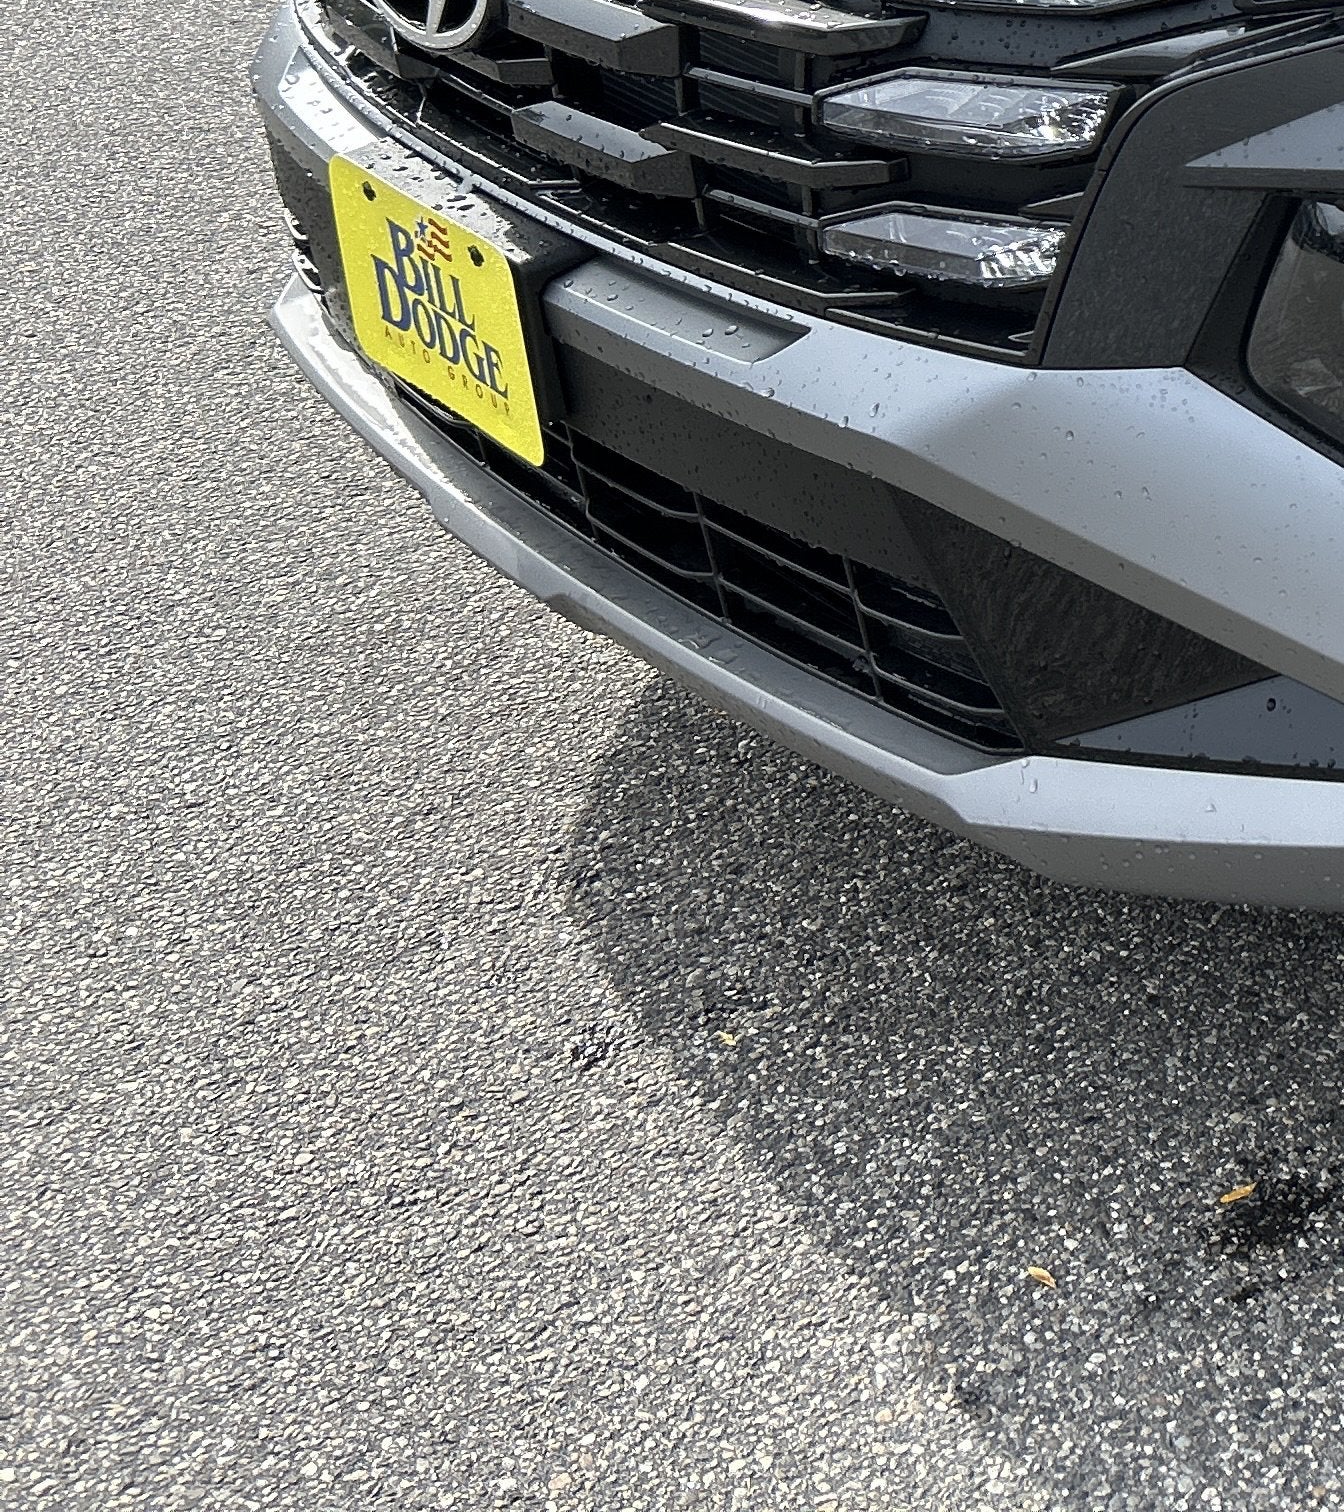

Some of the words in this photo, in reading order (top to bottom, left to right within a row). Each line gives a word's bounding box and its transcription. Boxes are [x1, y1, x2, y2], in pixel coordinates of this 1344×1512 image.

[371, 253, 508, 400] DODGE
[386, 217, 476, 332] BILL
[384, 325, 431, 364] AUTO
[447, 365, 510, 415] GROUP
